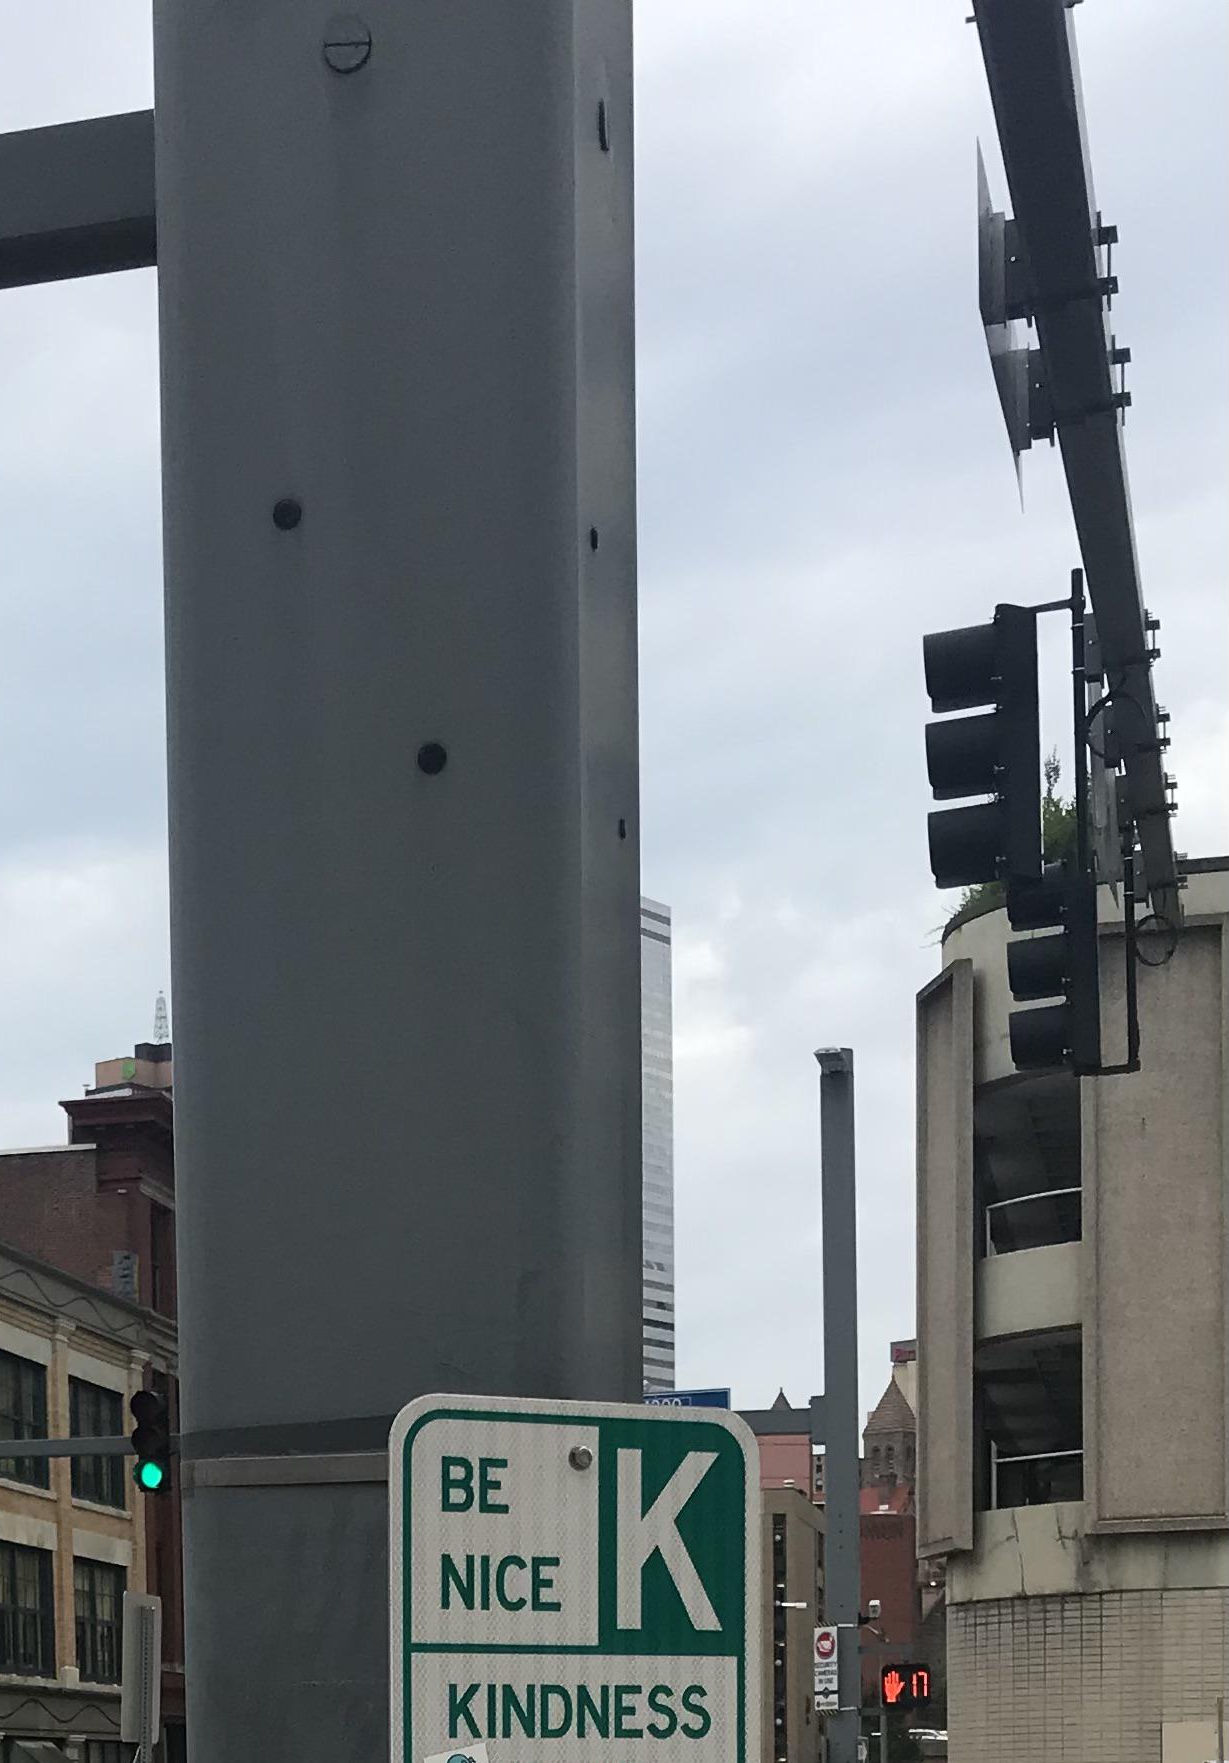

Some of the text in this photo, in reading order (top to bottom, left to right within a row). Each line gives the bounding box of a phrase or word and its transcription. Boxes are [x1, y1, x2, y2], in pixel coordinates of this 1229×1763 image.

[440, 1454, 509, 1514] BE
[616, 1447, 723, 1633] K
[440, 1554, 562, 1611] NICE
[448, 1683, 712, 1740] KINDNESS
[912, 1671, 928, 1698] 17
